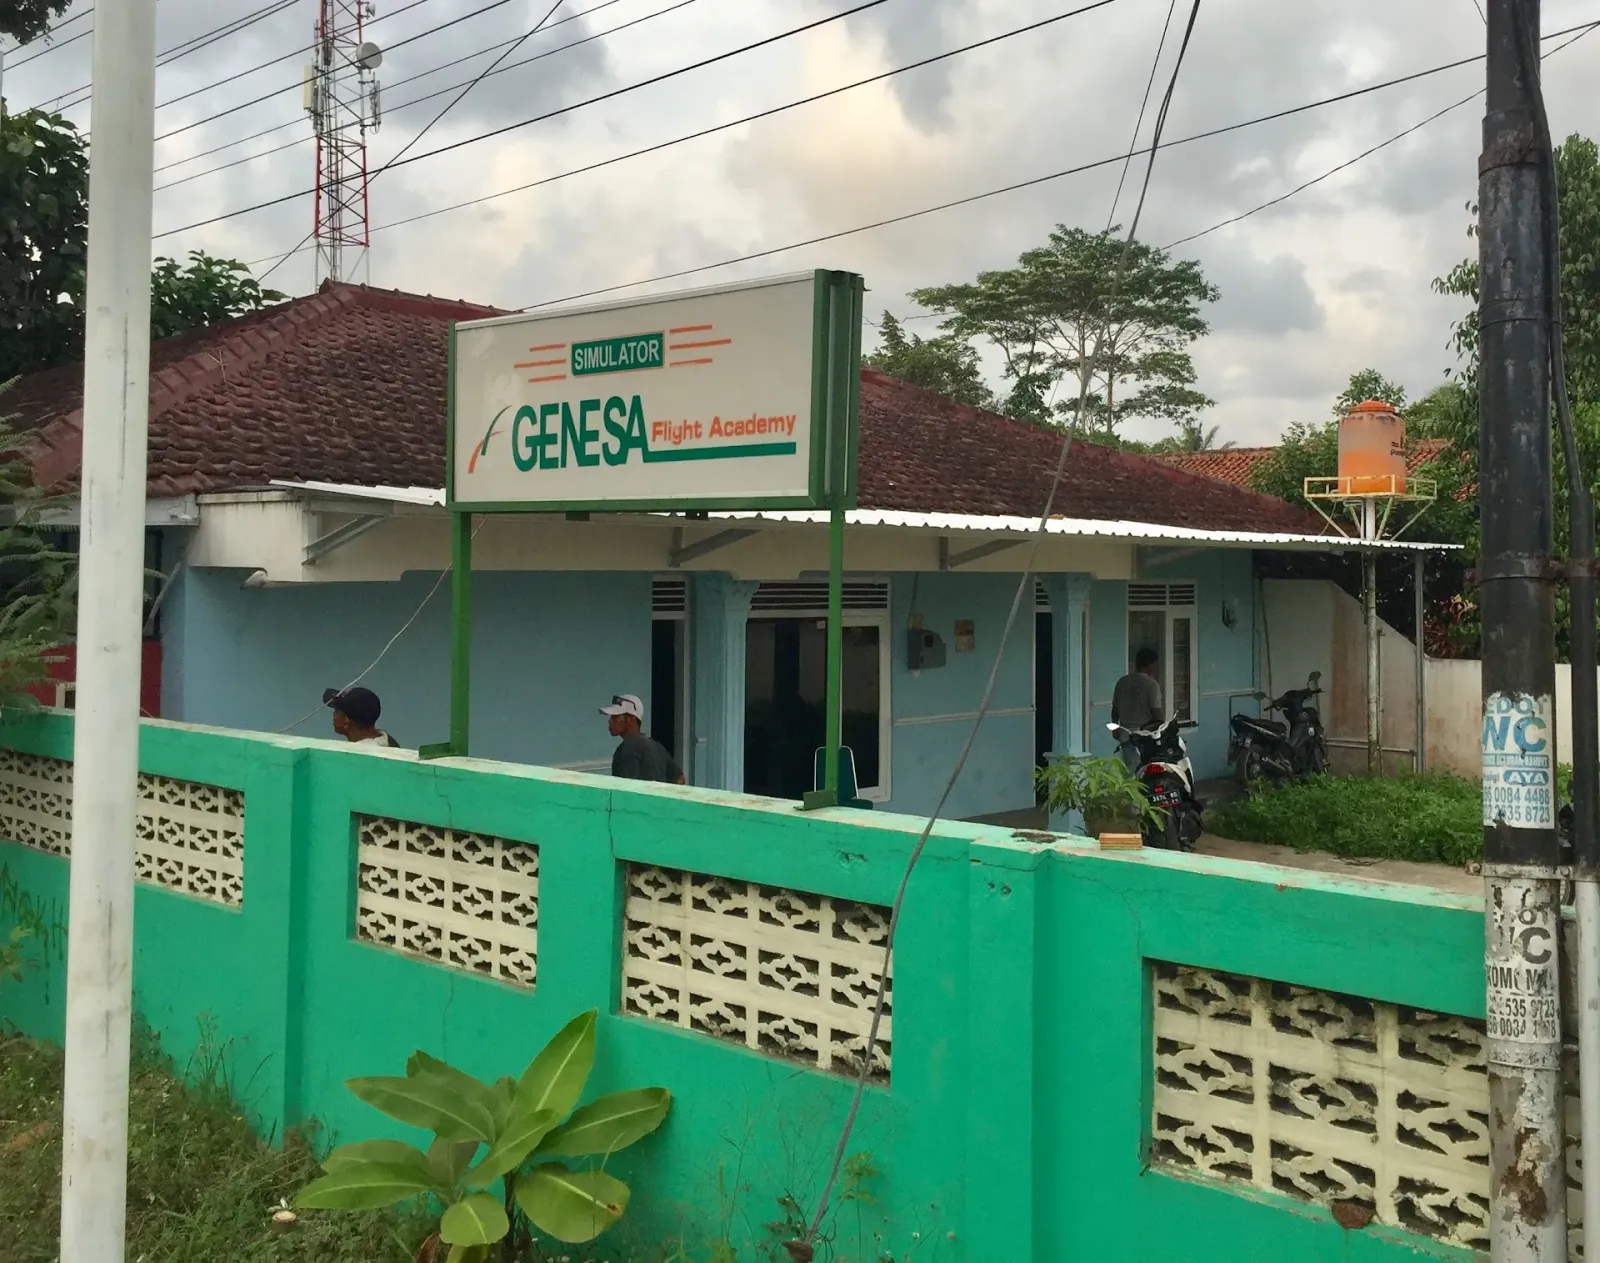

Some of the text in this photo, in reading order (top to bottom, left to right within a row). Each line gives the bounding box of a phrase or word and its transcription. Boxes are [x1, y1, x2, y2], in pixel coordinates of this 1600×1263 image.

[574, 339, 660, 371] SIMULATOR
[512, 394, 796, 472] GENESA Flight Academy
